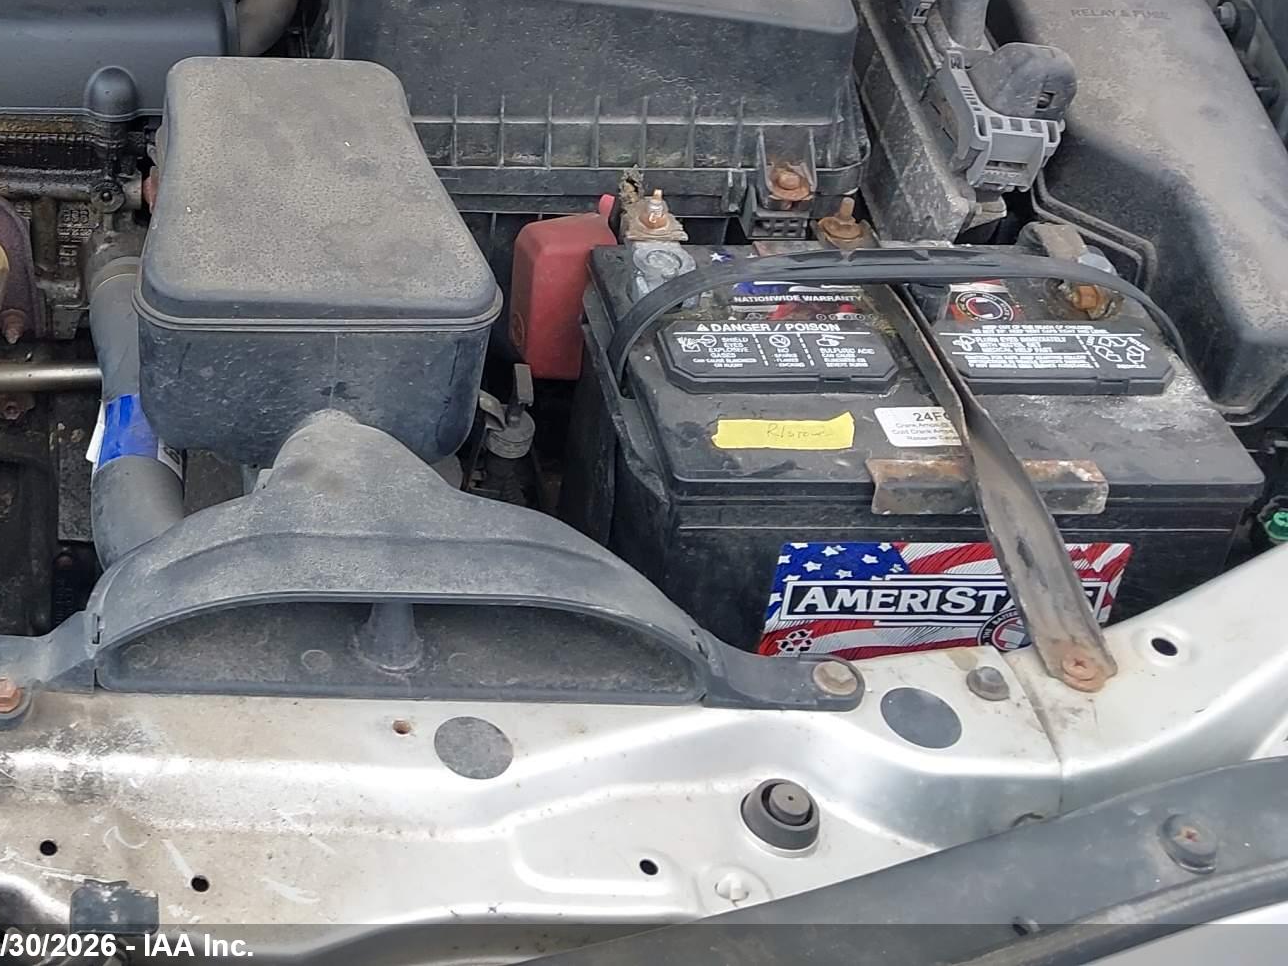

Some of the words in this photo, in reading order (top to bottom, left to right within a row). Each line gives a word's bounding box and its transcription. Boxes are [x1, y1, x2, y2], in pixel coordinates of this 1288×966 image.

[733, 294, 800, 302] NATIONWIDE
[802, 294, 862, 302] WARRANTY
[711, 323, 772, 332] DANGER
[785, 323, 841, 332] POISON
[797, 586, 1017, 614] AMERIST
